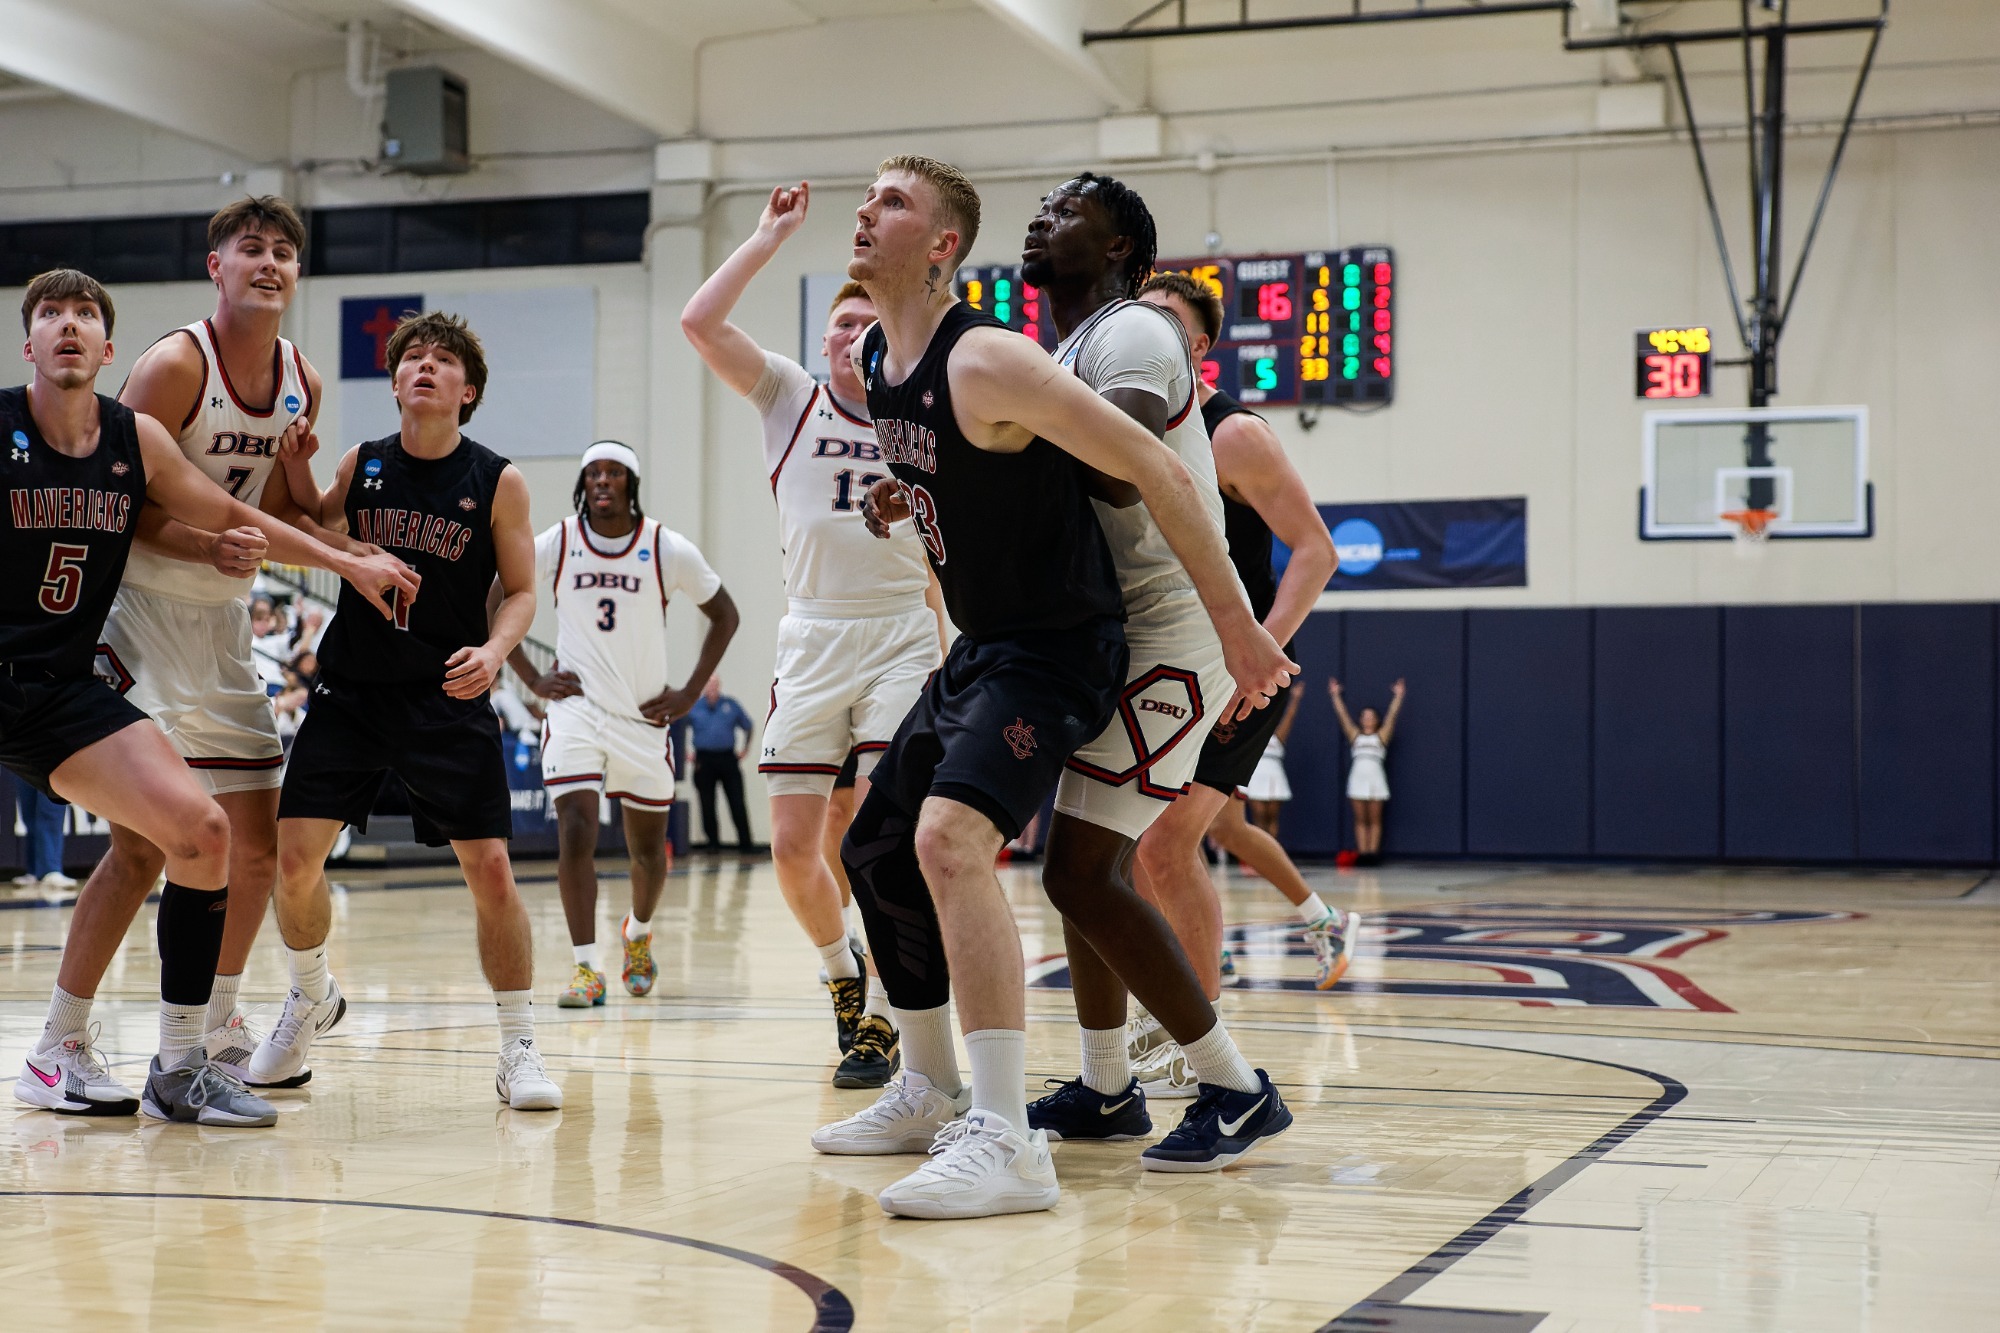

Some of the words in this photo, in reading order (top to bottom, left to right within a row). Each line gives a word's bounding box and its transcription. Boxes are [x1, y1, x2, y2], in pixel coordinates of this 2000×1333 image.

[1237, 260, 1290, 281] GUEST
[1319, 266, 1330, 287] 1
[1258, 283, 1292, 320] 16
[1313, 289, 1329, 311] 5
[1374, 286, 1391, 309] 2
[1306, 312, 1330, 334] 11
[1350, 311, 1360, 332] 1
[1300, 335, 1329, 357] 21
[1374, 333, 1391, 355] 4
[1256, 358, 1277, 390] 5
[1300, 358, 1329, 381] 33
[1343, 357, 1360, 380] 2
[1374, 356, 1391, 378] 4
[1645, 354, 1700, 398] 30
[812, 437, 883, 462] DB
[224, 465, 254, 500] 7
[10, 487, 131, 534] MAVERICKS
[357, 508, 472, 561] MAVERICKS
[38, 542, 89, 615] 5
[573, 571, 642, 594] DBU
[596, 596, 617, 633] 3
[1138, 698, 1188, 720] DBU
